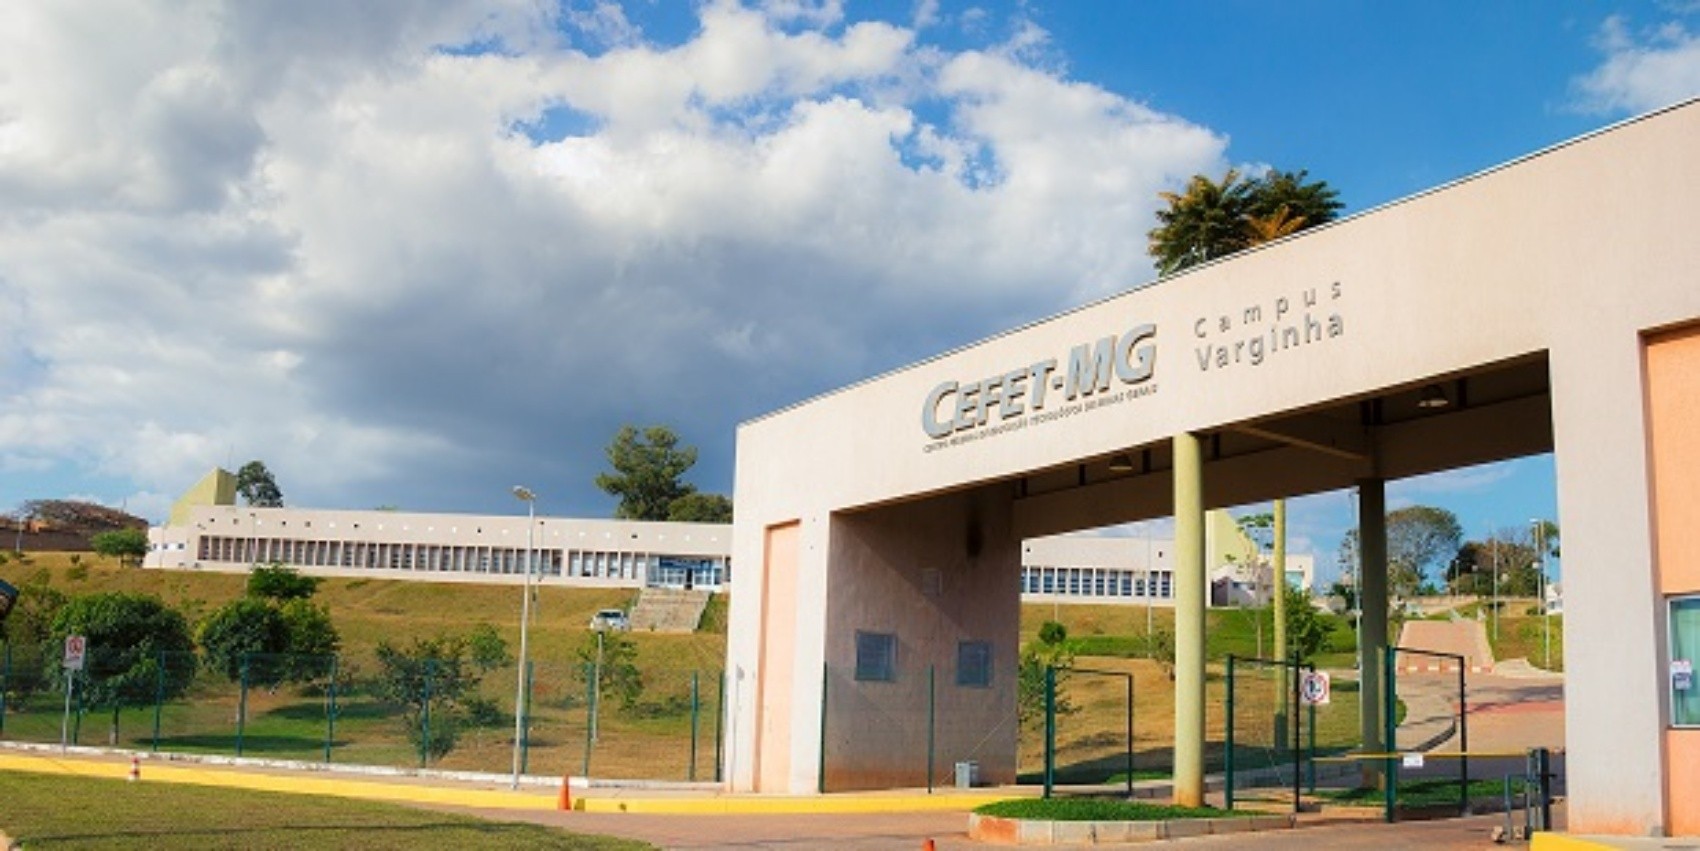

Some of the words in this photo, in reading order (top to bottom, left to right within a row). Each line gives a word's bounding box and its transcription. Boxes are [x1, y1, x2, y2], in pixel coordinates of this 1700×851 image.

[1194, 281, 1341, 338] Campus
[1194, 313, 1343, 371] Varginha
[922, 323, 1157, 439] CEFET-MG
